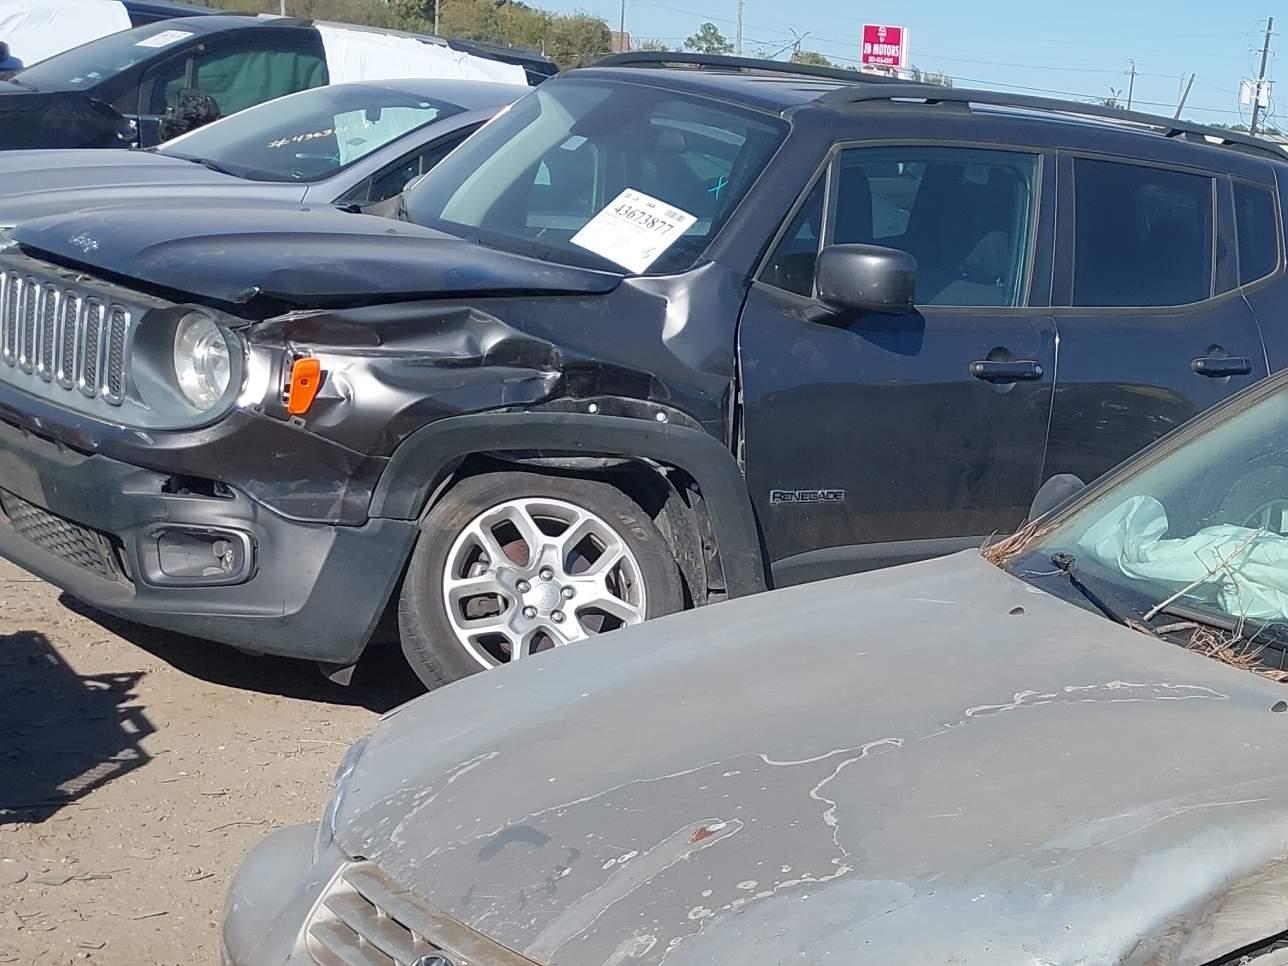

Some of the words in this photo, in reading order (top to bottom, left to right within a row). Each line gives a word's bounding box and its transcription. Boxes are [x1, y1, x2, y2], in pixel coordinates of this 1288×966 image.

[872, 43, 900, 57] MOTORS
[614, 203, 675, 236] 43673877
[769, 489, 845, 505] RENEGADE
